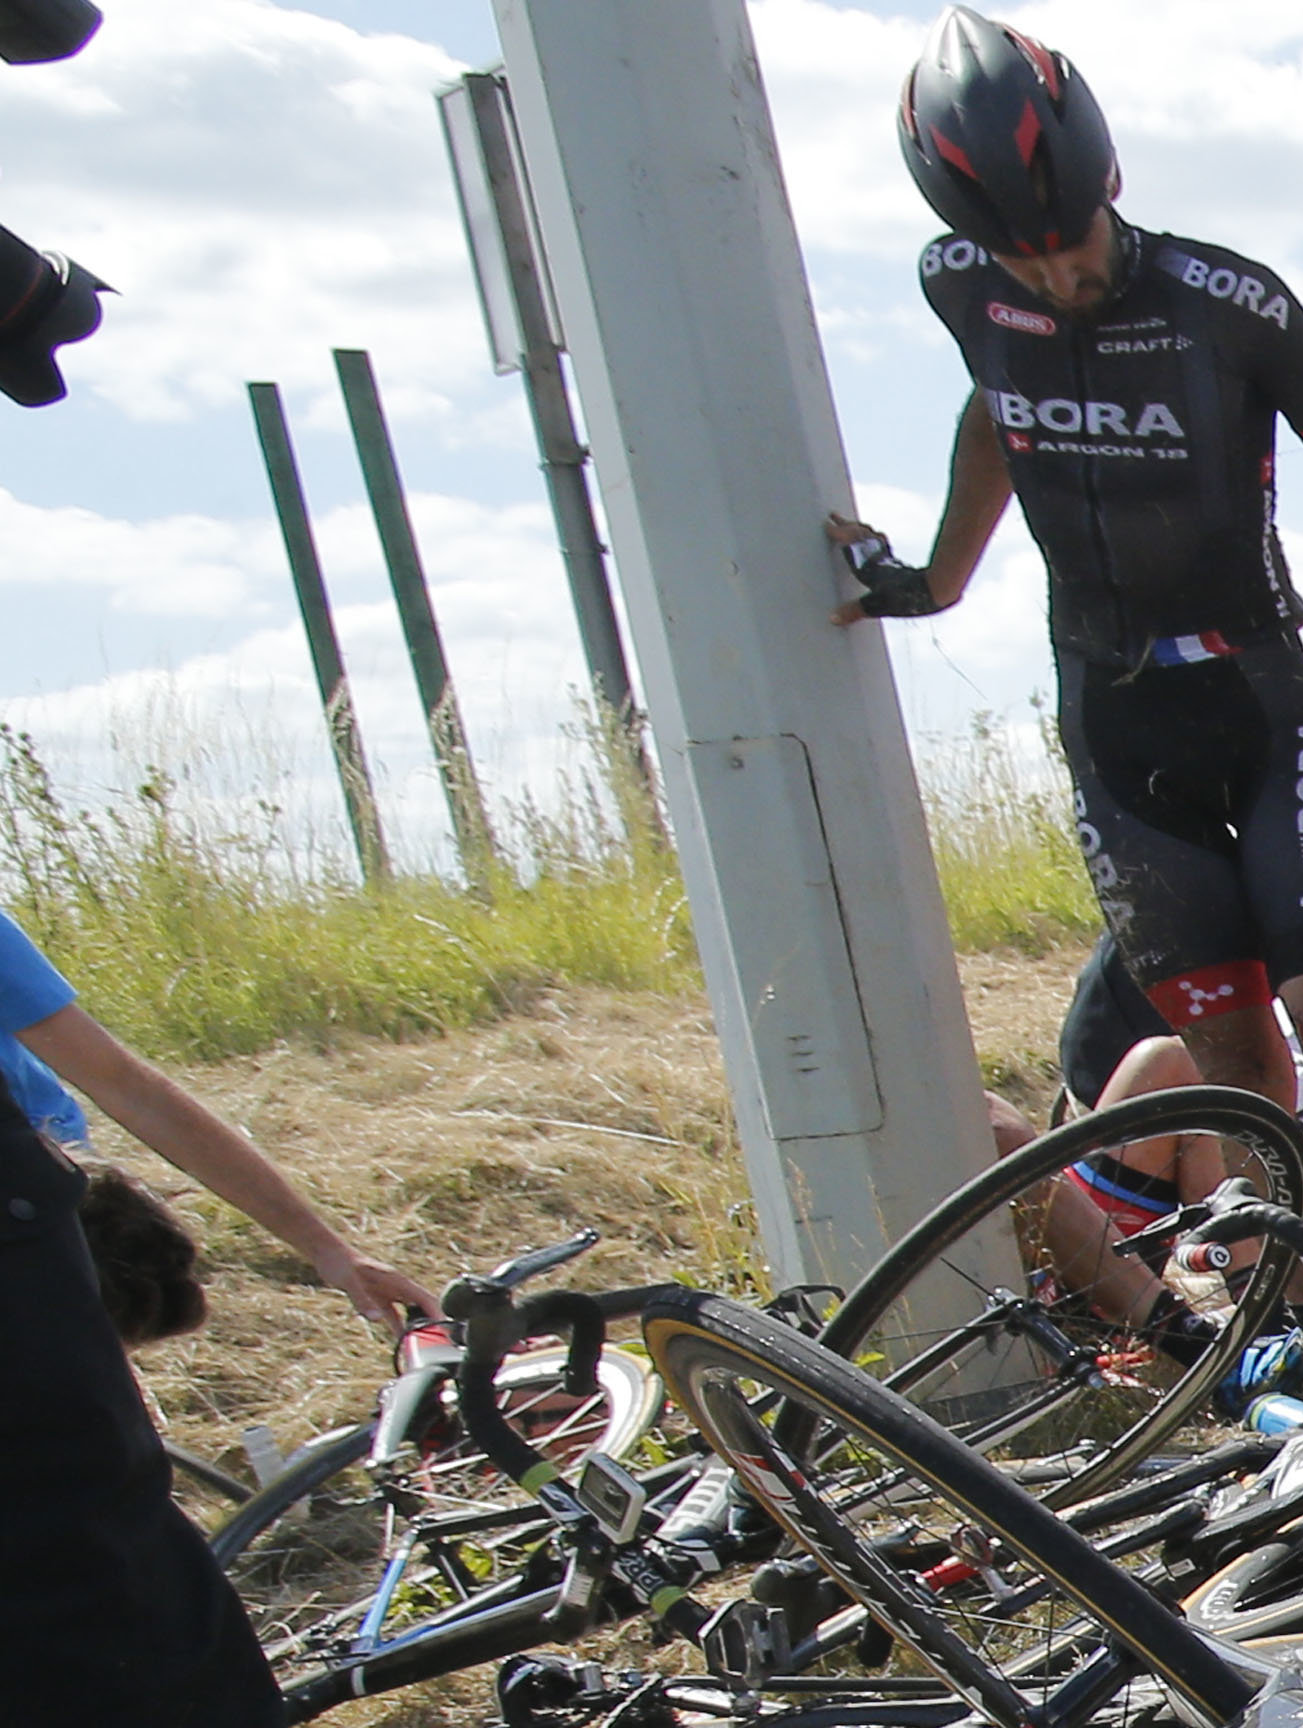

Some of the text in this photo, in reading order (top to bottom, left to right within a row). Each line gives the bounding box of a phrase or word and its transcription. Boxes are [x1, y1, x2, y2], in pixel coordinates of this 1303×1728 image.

[1182, 257, 1290, 330] BORA
[1097, 337, 1172, 354] CRAFT
[1001, 392, 1185, 438] BORA
[1037, 441, 1189, 459] ARGON 18
